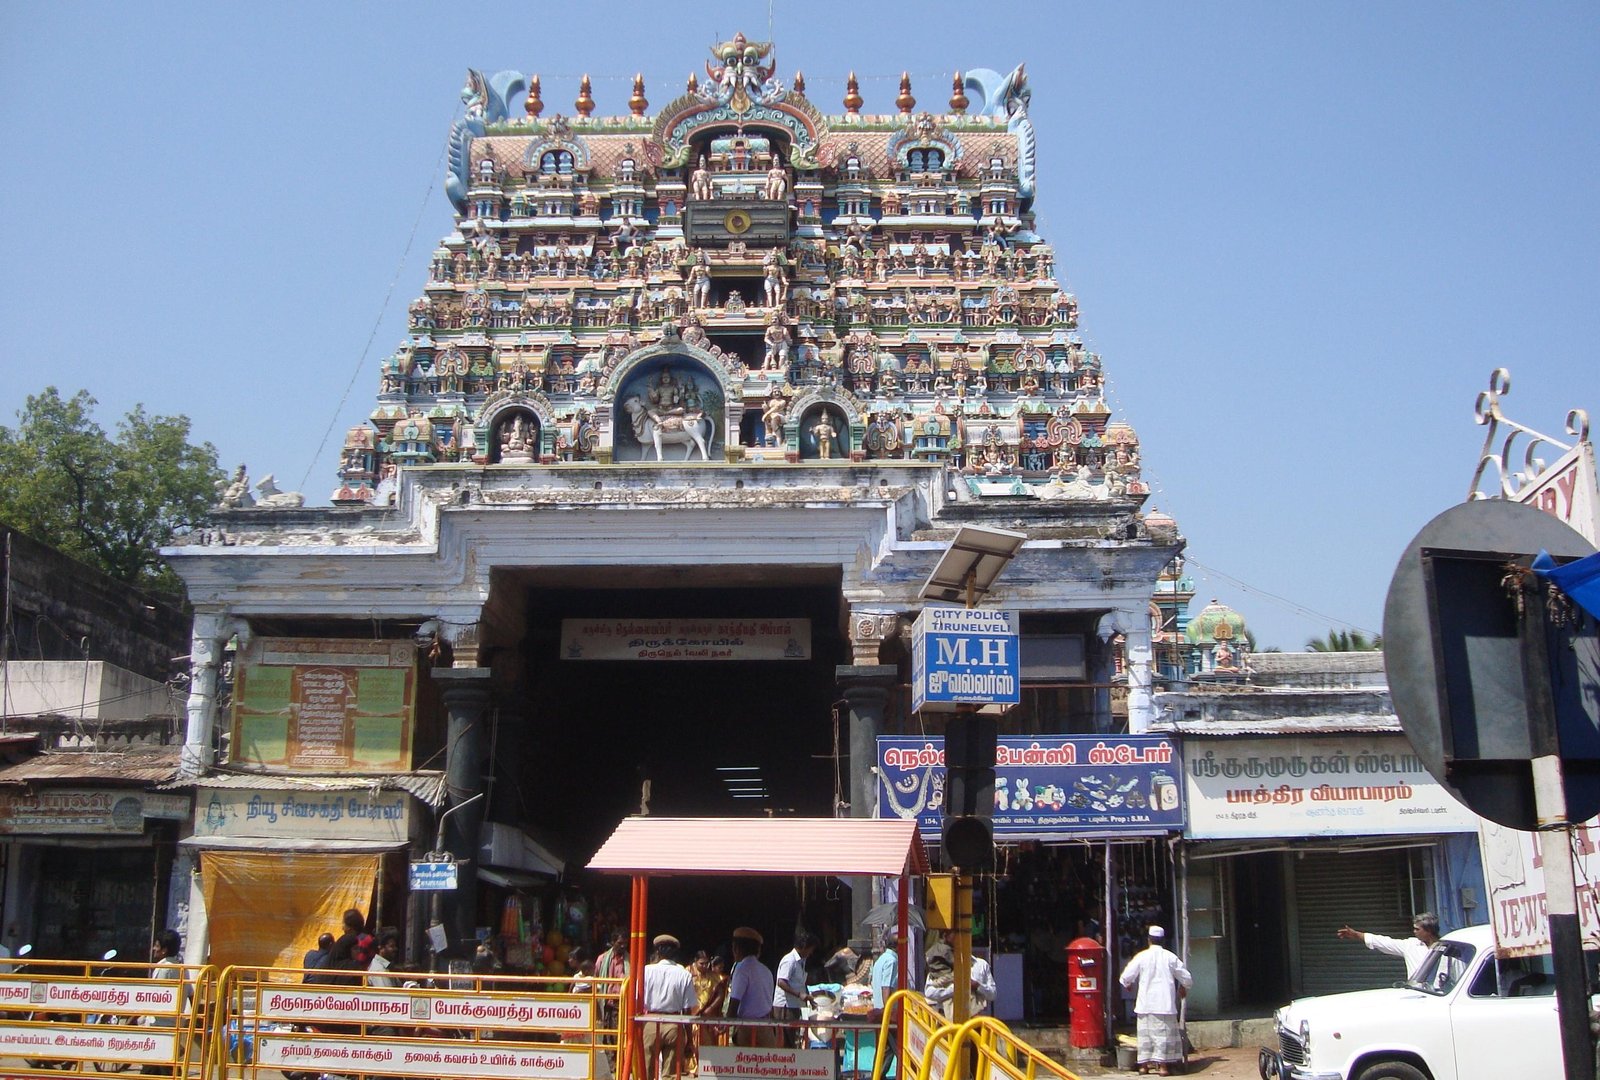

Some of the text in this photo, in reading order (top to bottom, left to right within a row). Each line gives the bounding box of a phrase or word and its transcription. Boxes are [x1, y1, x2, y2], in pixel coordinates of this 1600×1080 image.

[933, 610, 1010, 620] CITY POLICE
[932, 622, 1010, 632] TIRUNELVELI
[935, 638, 1009, 667] M.H
[884, 743, 945, 771] நெல்
[1088, 741, 1173, 764] ஸ்டோர்
[50, 985, 130, 1005] போக்குவரத்து
[135, 990, 173, 1004] காவல்
[435, 1000, 533, 1022] போக்குவரத்து
[536, 1005, 582, 1020] காவல்
[55, 1034, 105, 1048] இடங்களில்
[281, 1045, 565, 1070] தர்மம் தலைக் காக்கும் தலைக் கவசம் உயிர்க் காக்கும்
[735, 1051, 796, 1064] திருநெல்வேலி
[703, 1064, 829, 1077] மாநகர போக்குவரத்து காவல்
